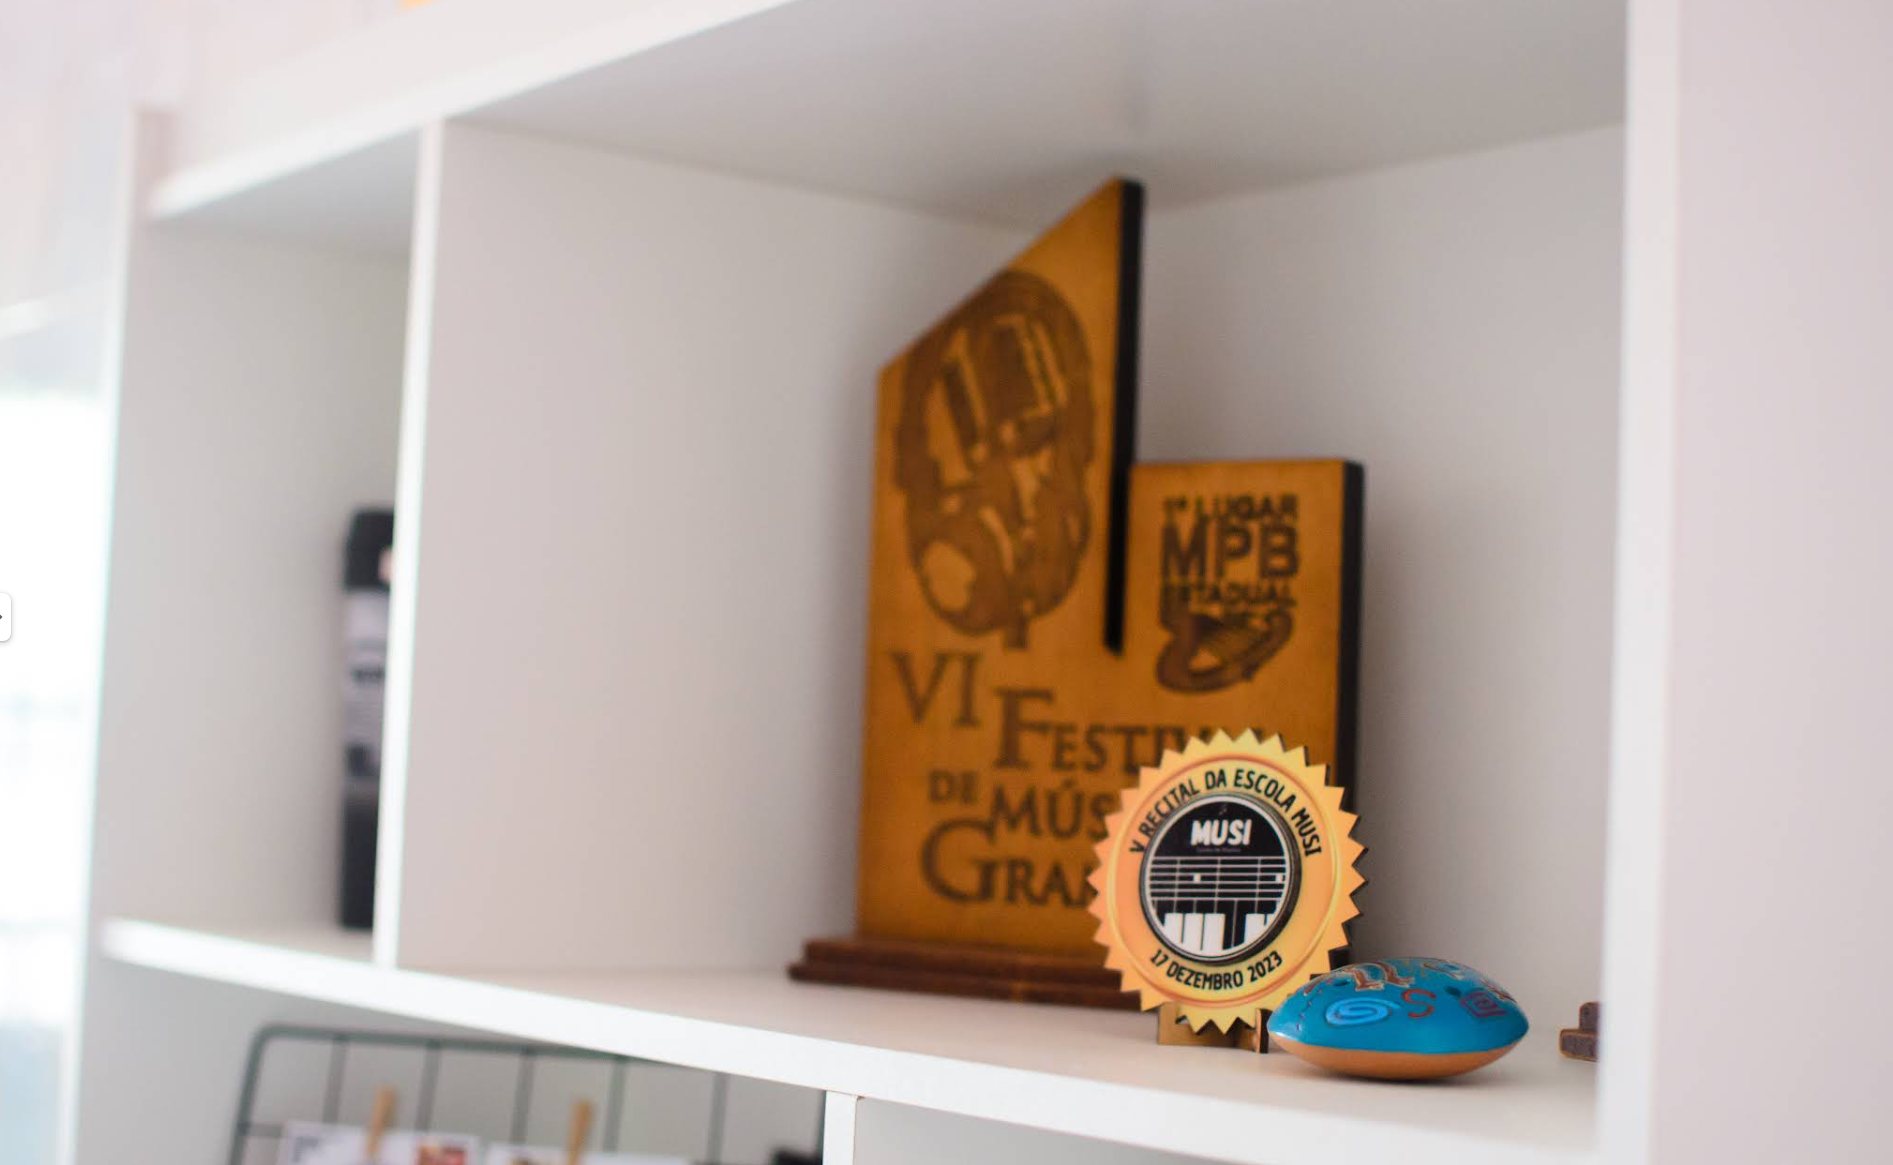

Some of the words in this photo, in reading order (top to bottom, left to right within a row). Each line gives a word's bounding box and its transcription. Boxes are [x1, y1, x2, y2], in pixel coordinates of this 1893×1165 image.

[1194, 493, 1299, 521] LUGAR
[1161, 517, 1300, 581] MPB
[891, 650, 984, 728] VI
[928, 769, 979, 805] DE
[1128, 840, 1146, 852] V
[1138, 778, 1201, 838] RECITAL
[1204, 768, 1228, 791] DA
[1233, 768, 1297, 813] ESCOLA
[1291, 807, 1322, 857] MUSI
[1190, 819, 1253, 846] MUSI
[1150, 949, 1170, 968] 17
[1165, 961, 1244, 991] DEZEMBRO
[1247, 950, 1283, 983] 2023
